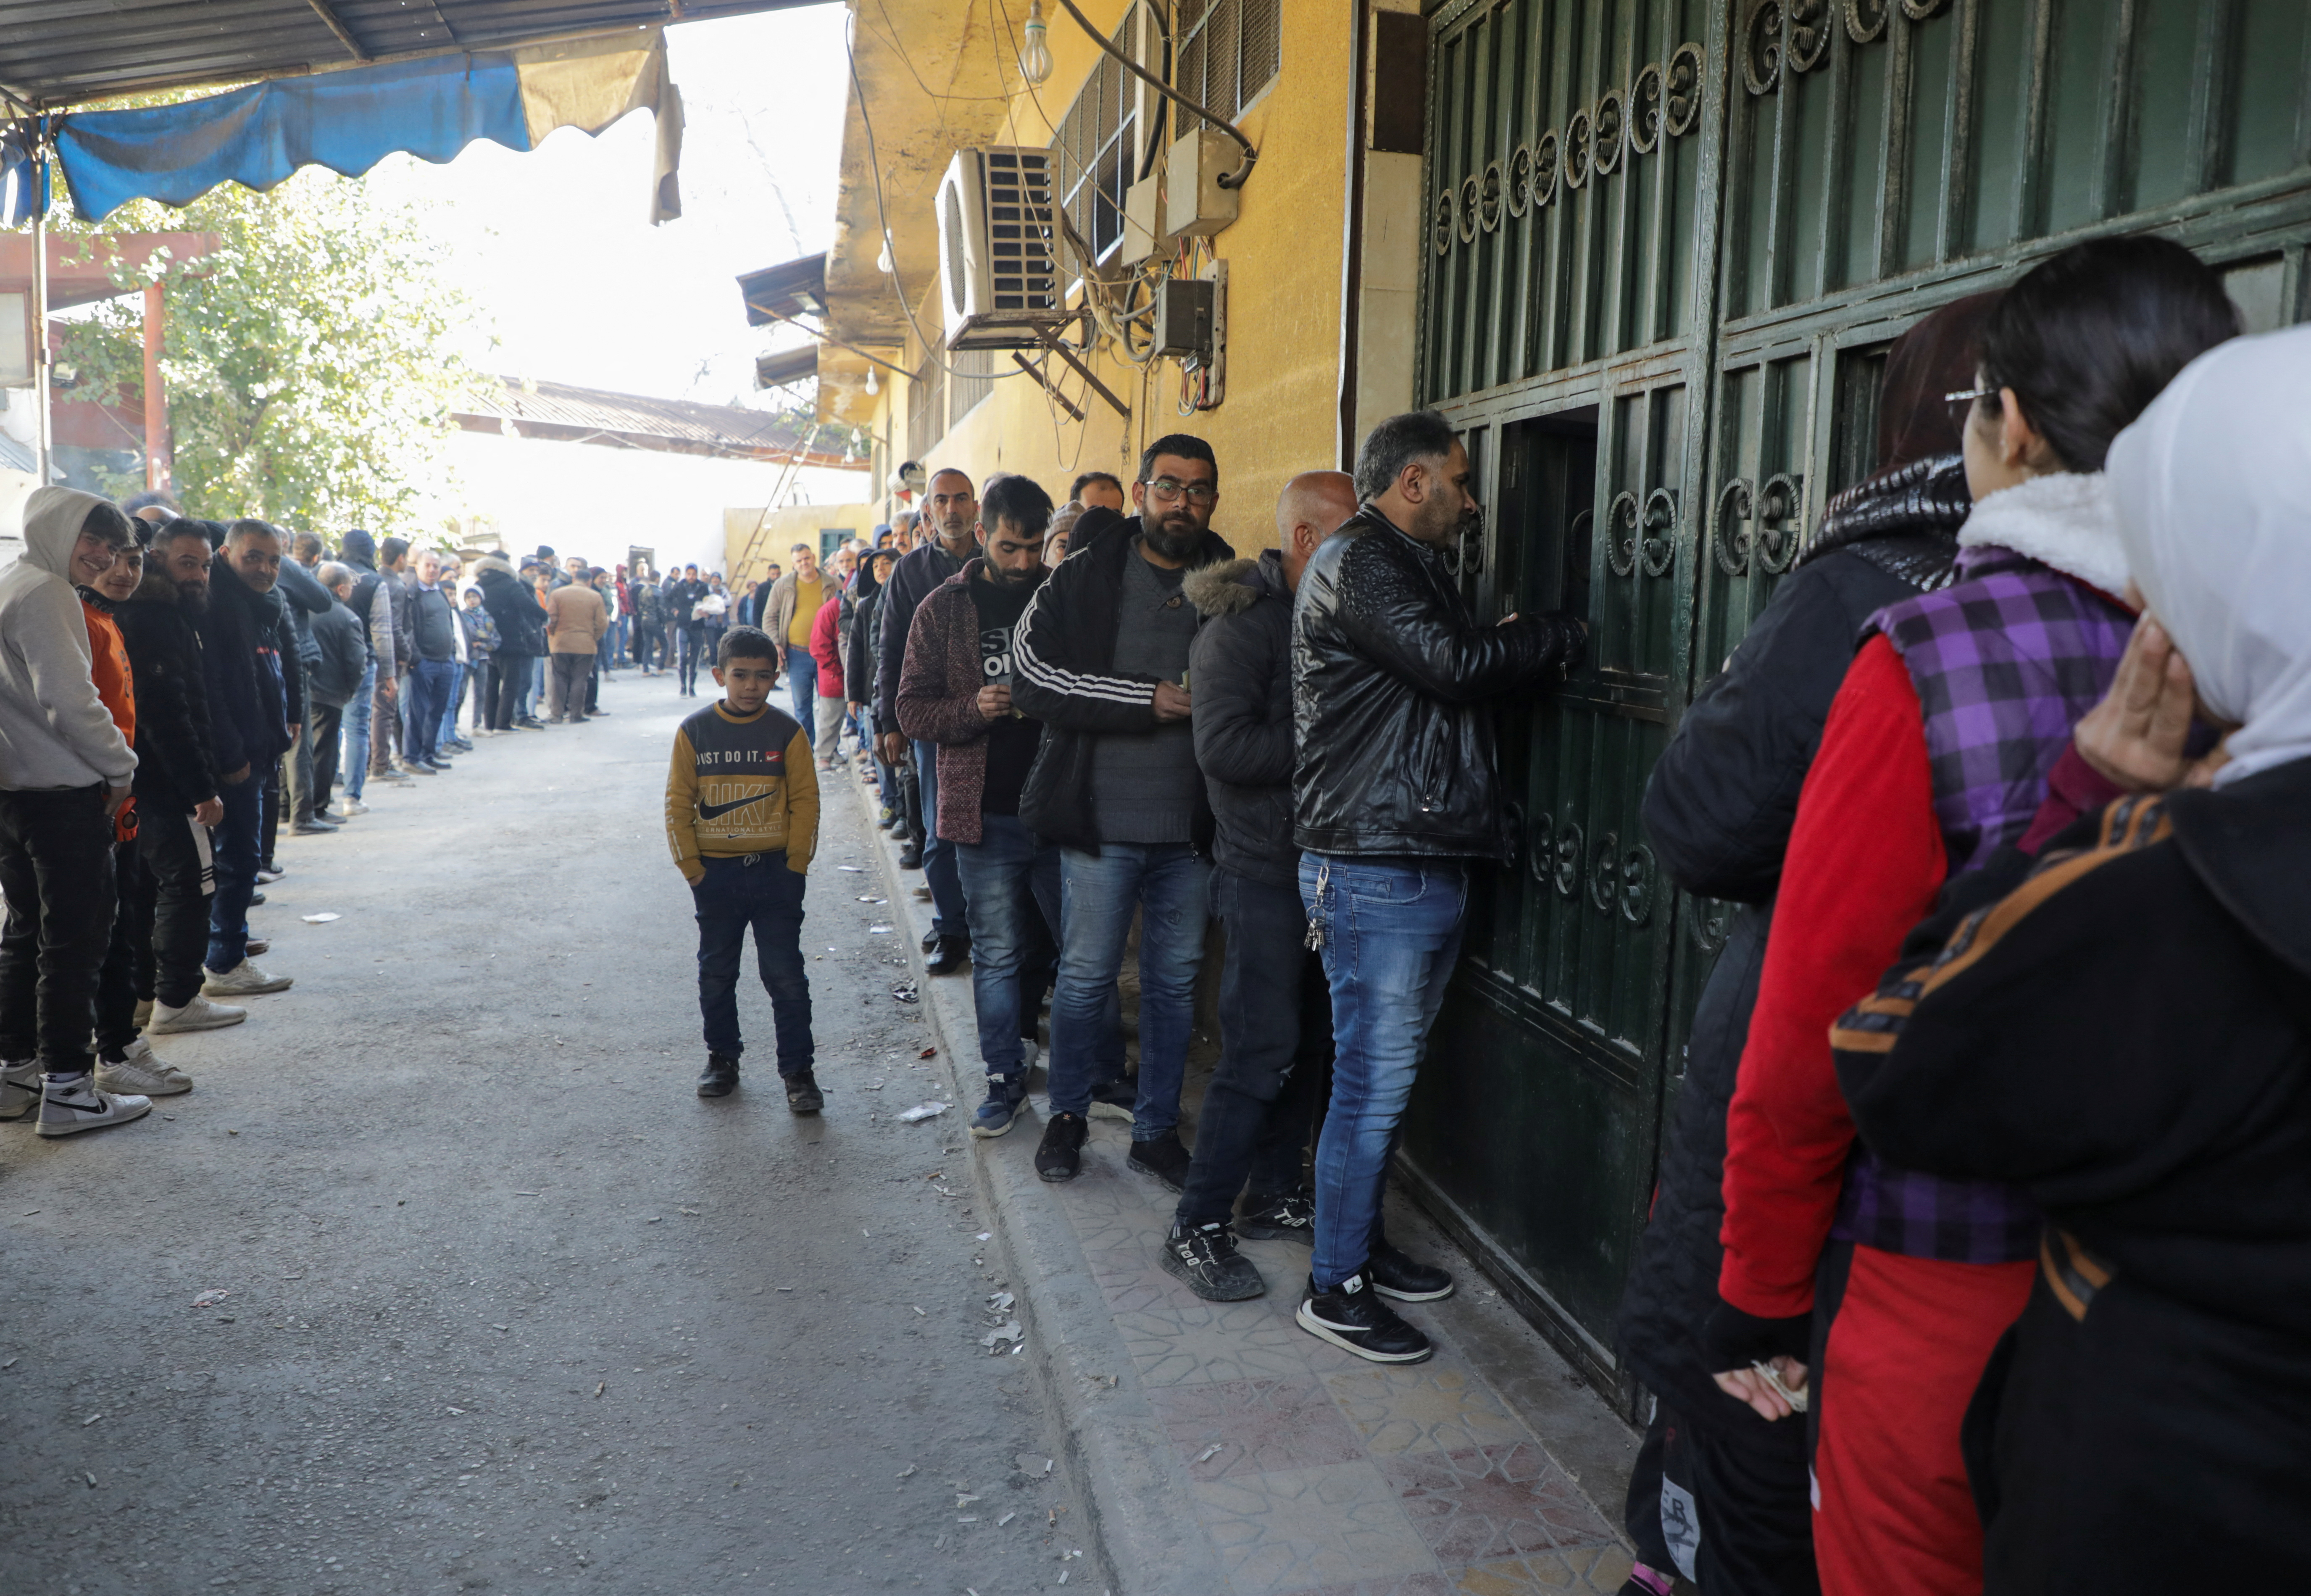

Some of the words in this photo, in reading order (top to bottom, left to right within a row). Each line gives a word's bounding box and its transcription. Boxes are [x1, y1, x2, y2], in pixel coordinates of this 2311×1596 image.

[696, 752, 719, 765] JUST
[725, 751, 741, 763] DO
[747, 751, 763, 762] IT.
[698, 783, 782, 825] NIKE
